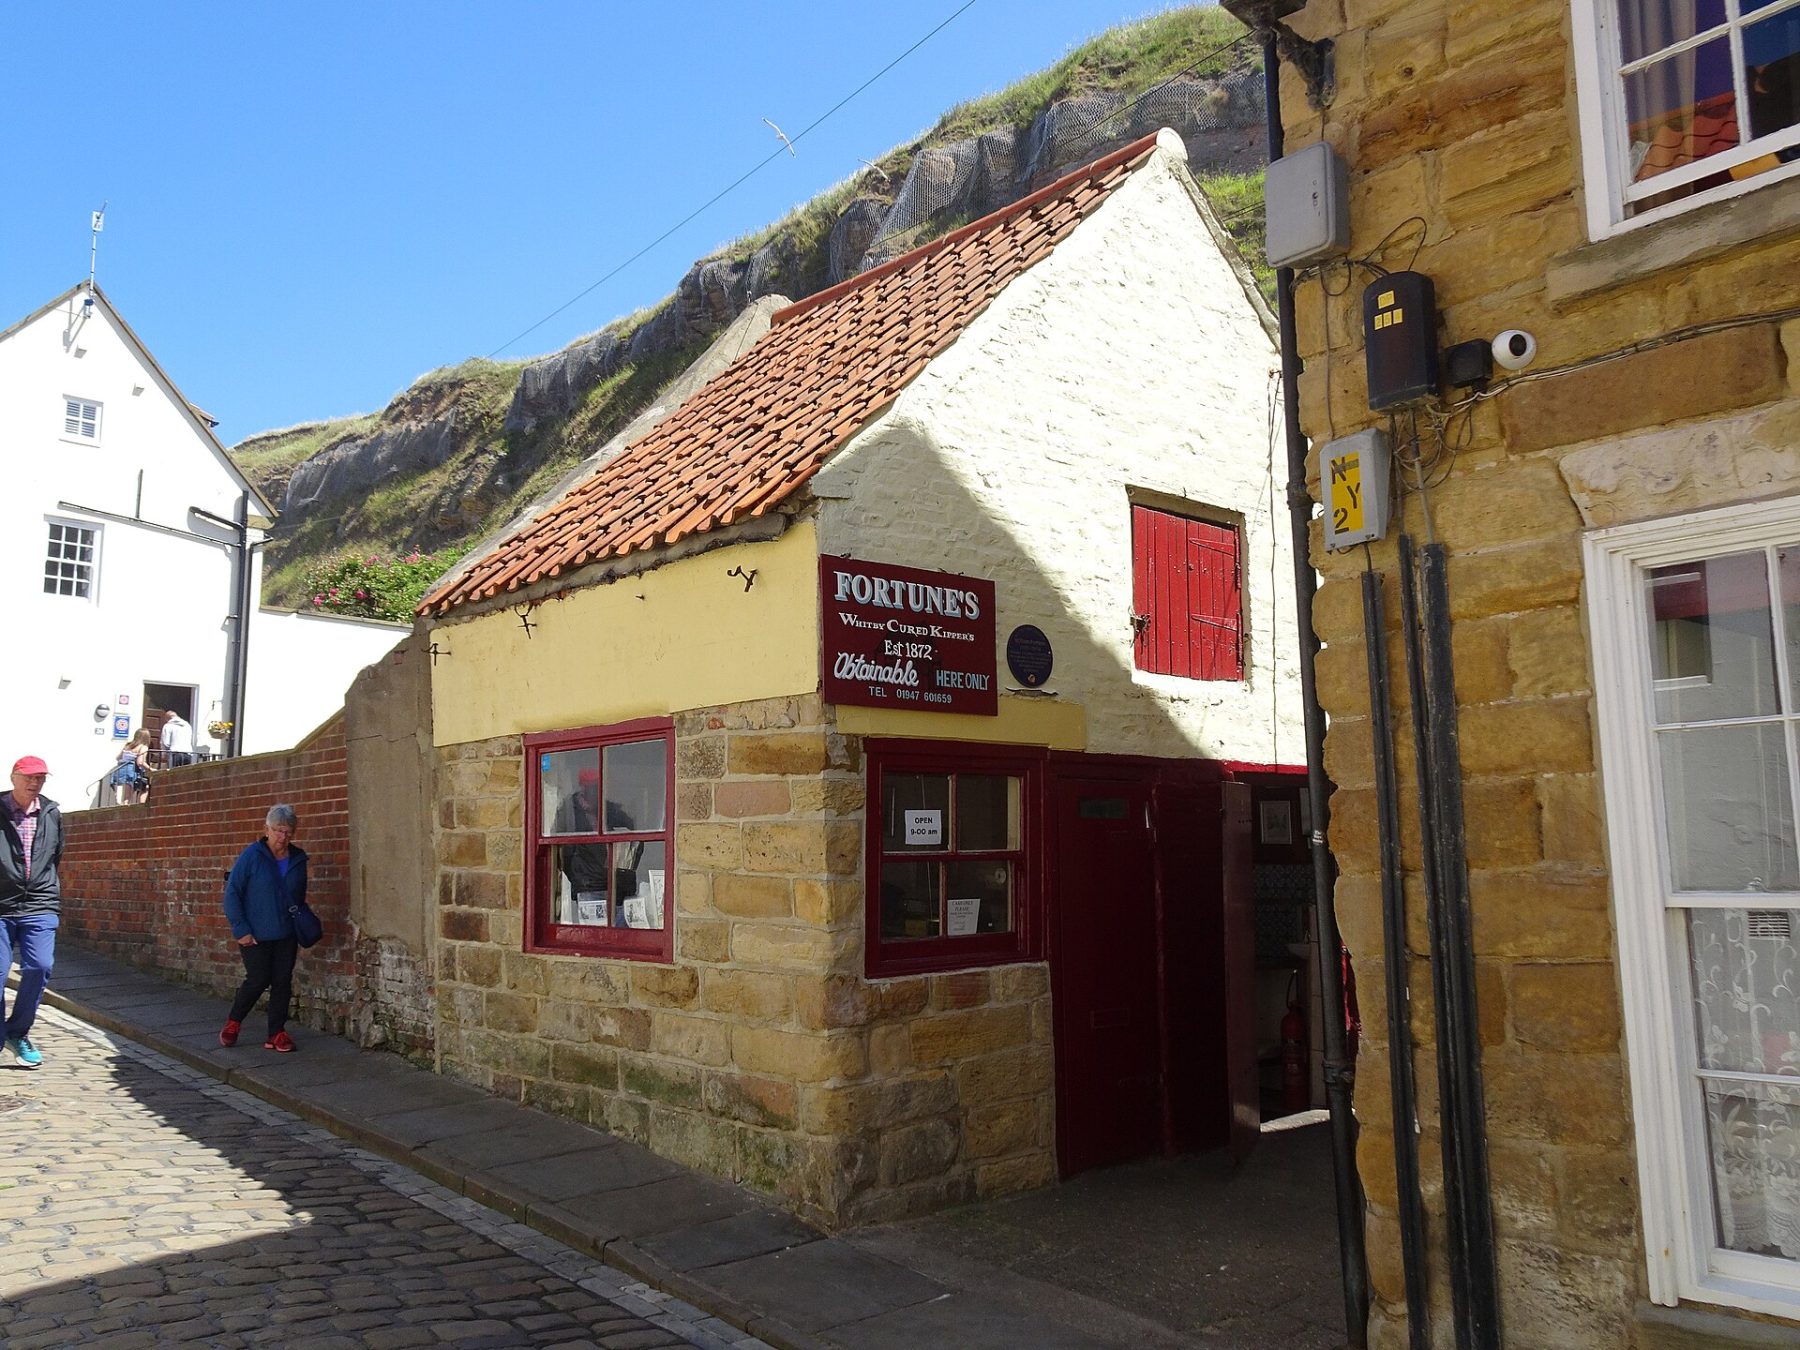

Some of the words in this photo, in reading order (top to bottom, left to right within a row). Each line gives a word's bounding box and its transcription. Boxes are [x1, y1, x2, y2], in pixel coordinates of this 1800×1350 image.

[1346, 482, 1360, 509] Y
[1333, 507, 1350, 535] 2
[833, 571, 980, 620] FORTUNE'S
[884, 639, 904, 657] Est
[905, 642, 933, 660] 1872
[834, 651, 919, 687] Obtainable
[936, 669, 964, 689] HERE
[965, 672, 990, 691] ONLY
[868, 686, 887, 698] TEL
[896, 689, 920, 701] 01947
[923, 692, 952, 704] 601659
